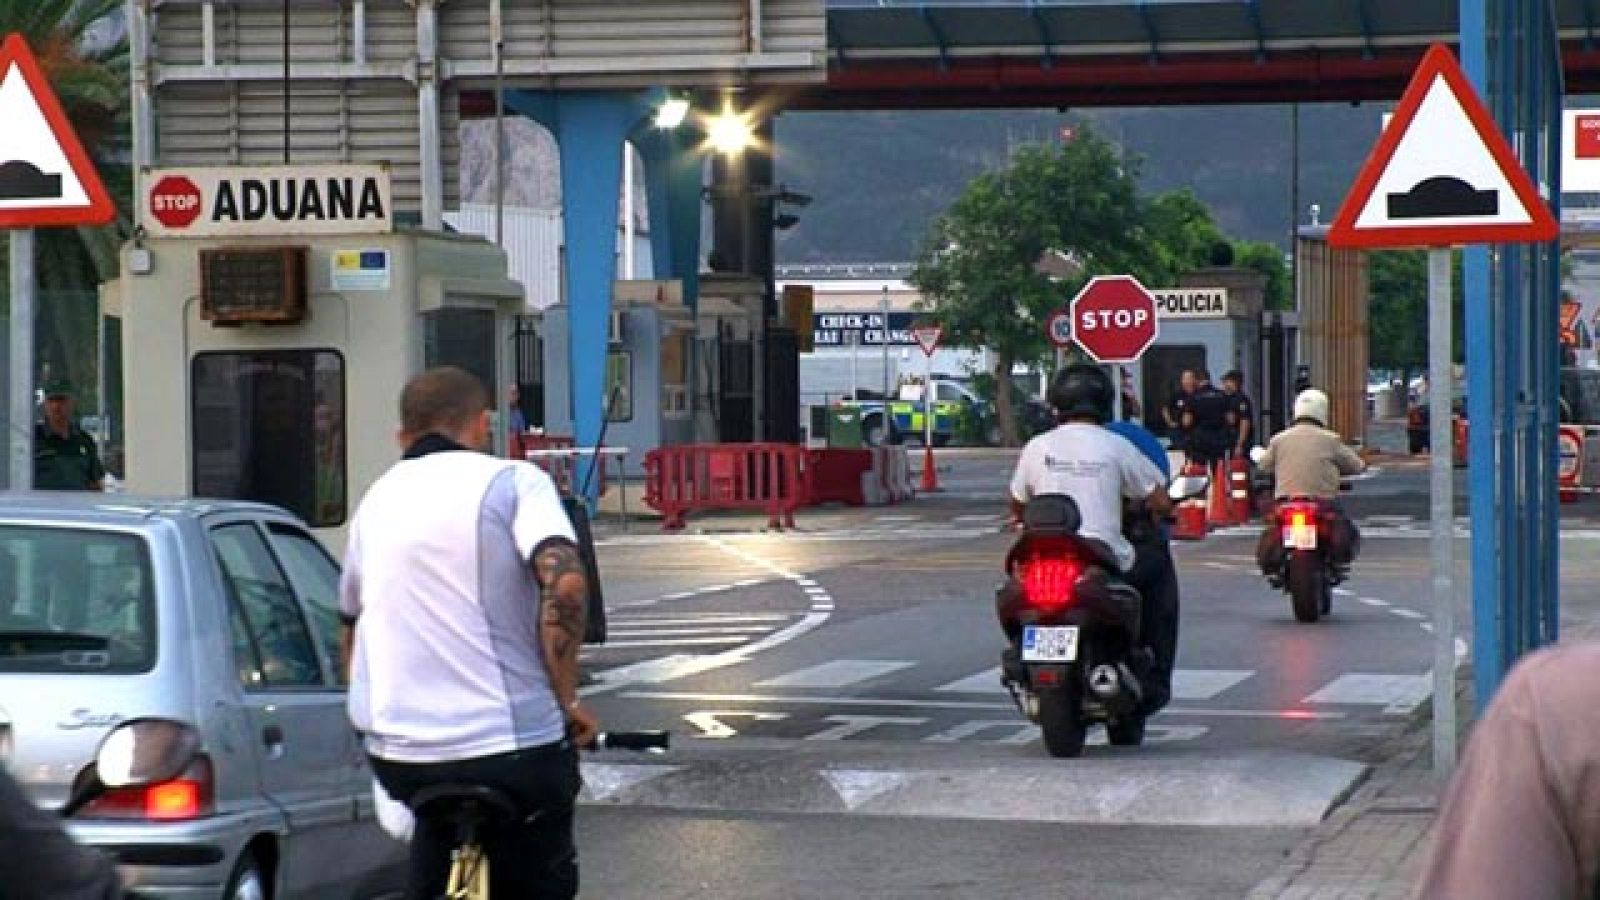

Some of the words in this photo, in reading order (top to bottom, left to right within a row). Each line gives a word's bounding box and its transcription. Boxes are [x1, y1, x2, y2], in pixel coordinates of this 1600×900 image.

[154, 194, 199, 211] STOP
[212, 178, 386, 221] ADUANA
[1155, 294, 1224, 313] POLICIA
[820, 314, 882, 328] CHECK-IN
[1082, 309, 1148, 331] STOP
